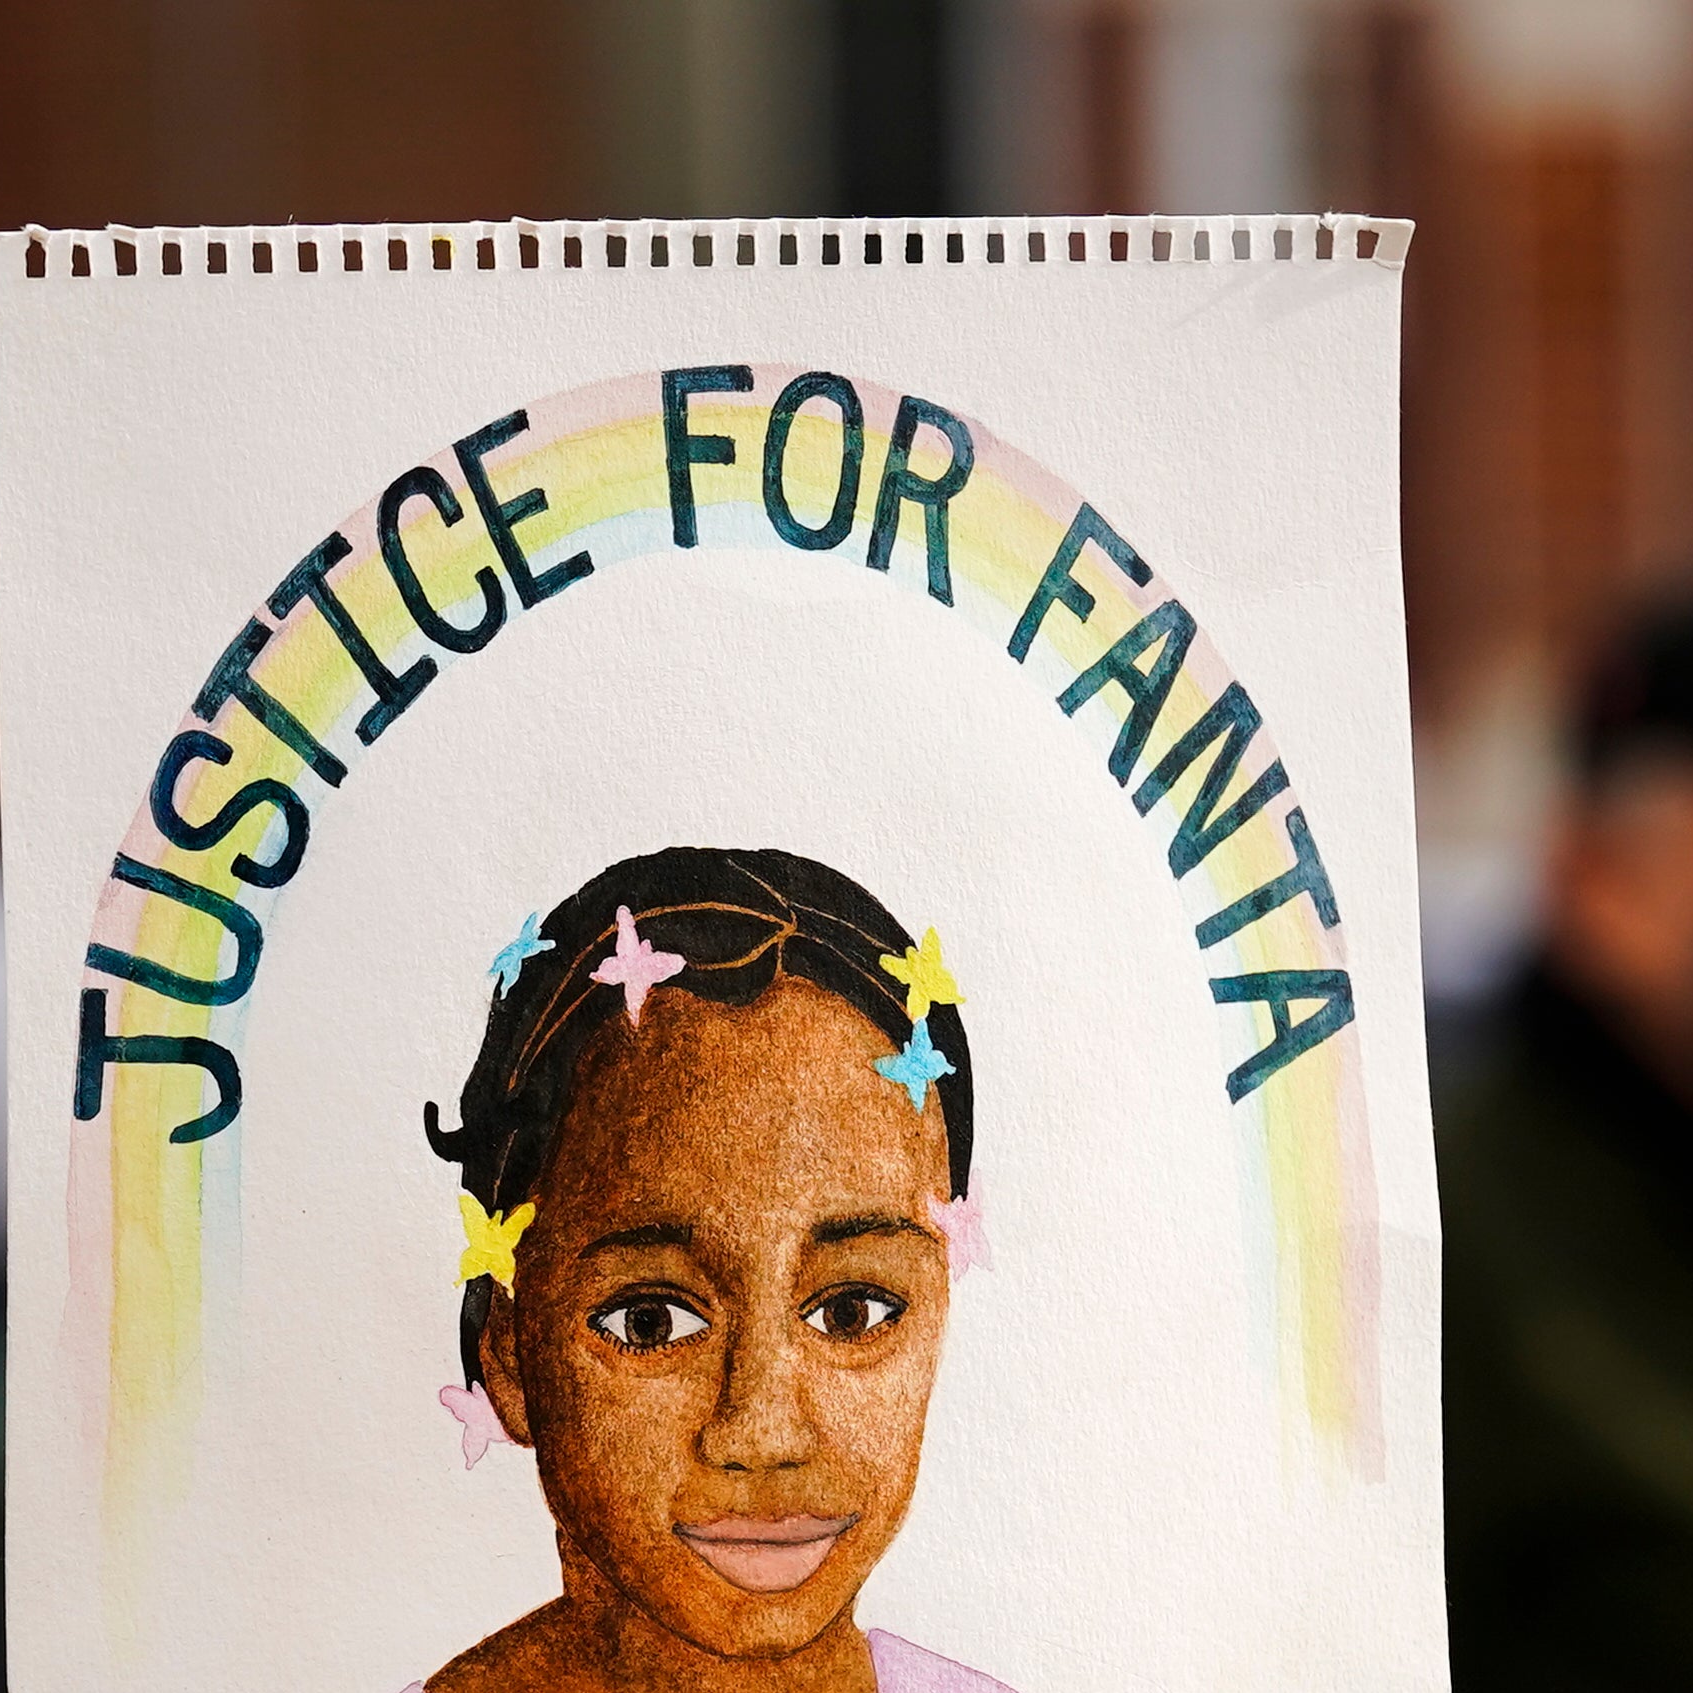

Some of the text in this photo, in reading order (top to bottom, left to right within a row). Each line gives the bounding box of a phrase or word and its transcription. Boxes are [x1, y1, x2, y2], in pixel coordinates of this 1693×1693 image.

[74, 365, 1356, 1143] JUSTICE FOR FANTA
